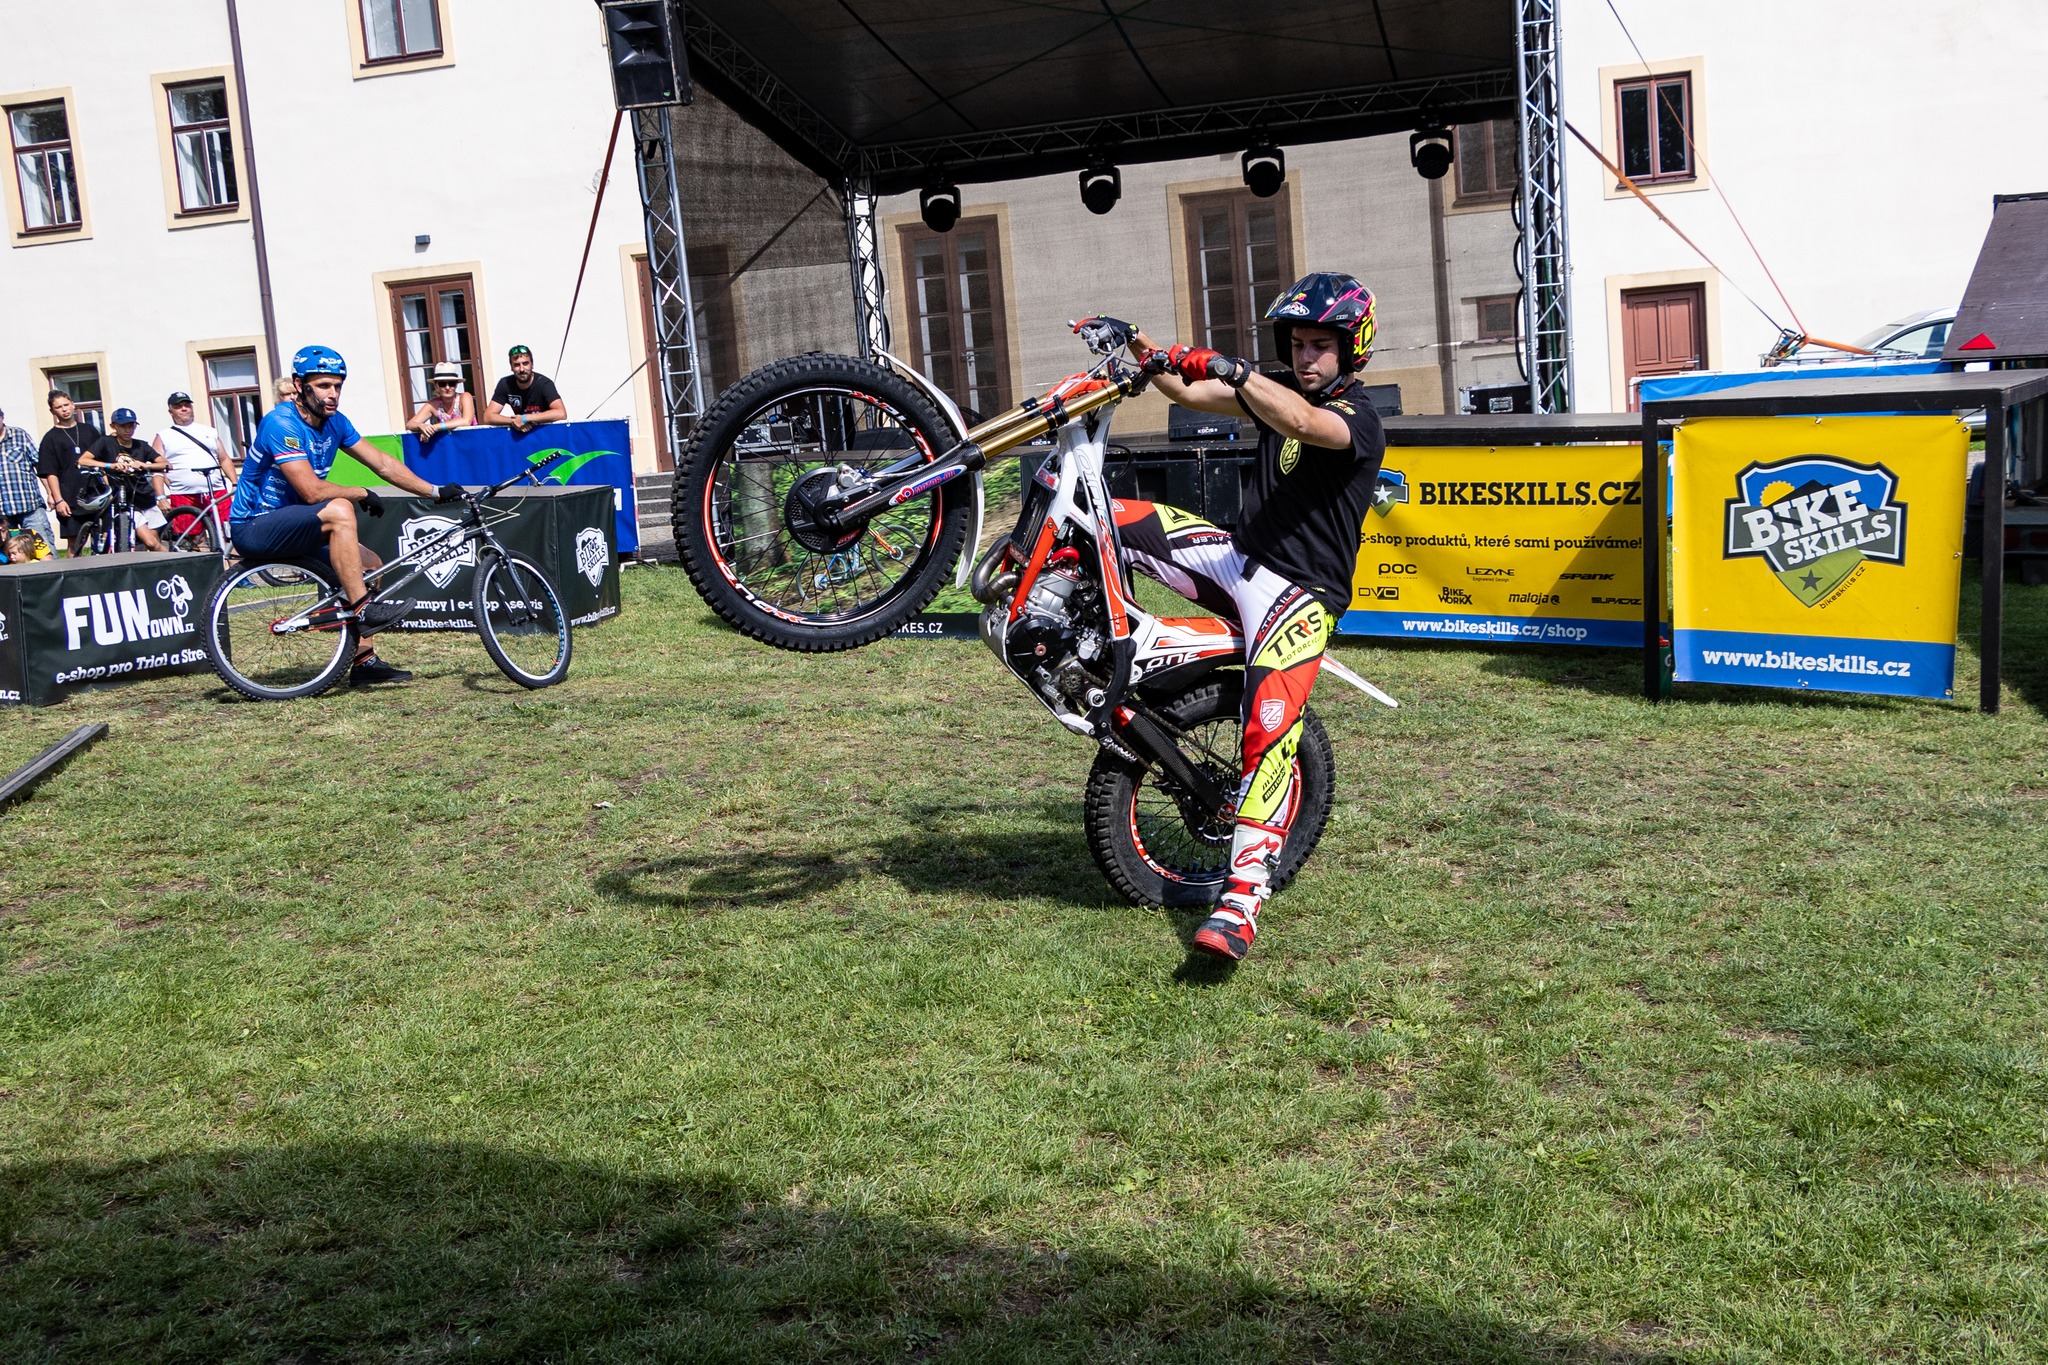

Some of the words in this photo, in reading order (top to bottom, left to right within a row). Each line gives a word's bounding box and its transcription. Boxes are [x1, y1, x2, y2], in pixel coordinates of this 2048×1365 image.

[1419, 480, 1642, 506] BIKESKILLS.CZ
[1742, 479, 1869, 550] BIKE
[1405, 533, 1471, 548] produktů,
[1474, 534, 1510, 548] které
[1514, 536, 1550, 549] sami
[1554, 536, 1643, 551] používáme!
[1783, 513, 1892, 566] SKILLS
[1466, 566, 1515, 576] LEZYNE
[1358, 587, 1398, 599] DVO
[1442, 586, 1464, 597] BIKE
[1508, 592, 1549, 605] maloja
[1819, 566, 1866, 610] bikeskills.cz
[458, 600, 500, 612] e-sop
[1256, 585, 1305, 643] Z-TRAILE
[1403, 619, 1588, 640] www.bikeskills.cz/shop
[56, 665, 106, 684] e-shop
[108, 661, 133, 678] pro
[136, 652, 167, 671] Trial
[171, 654, 180, 665] a
[1702, 649, 1911, 677] www.bikeskills.cz
